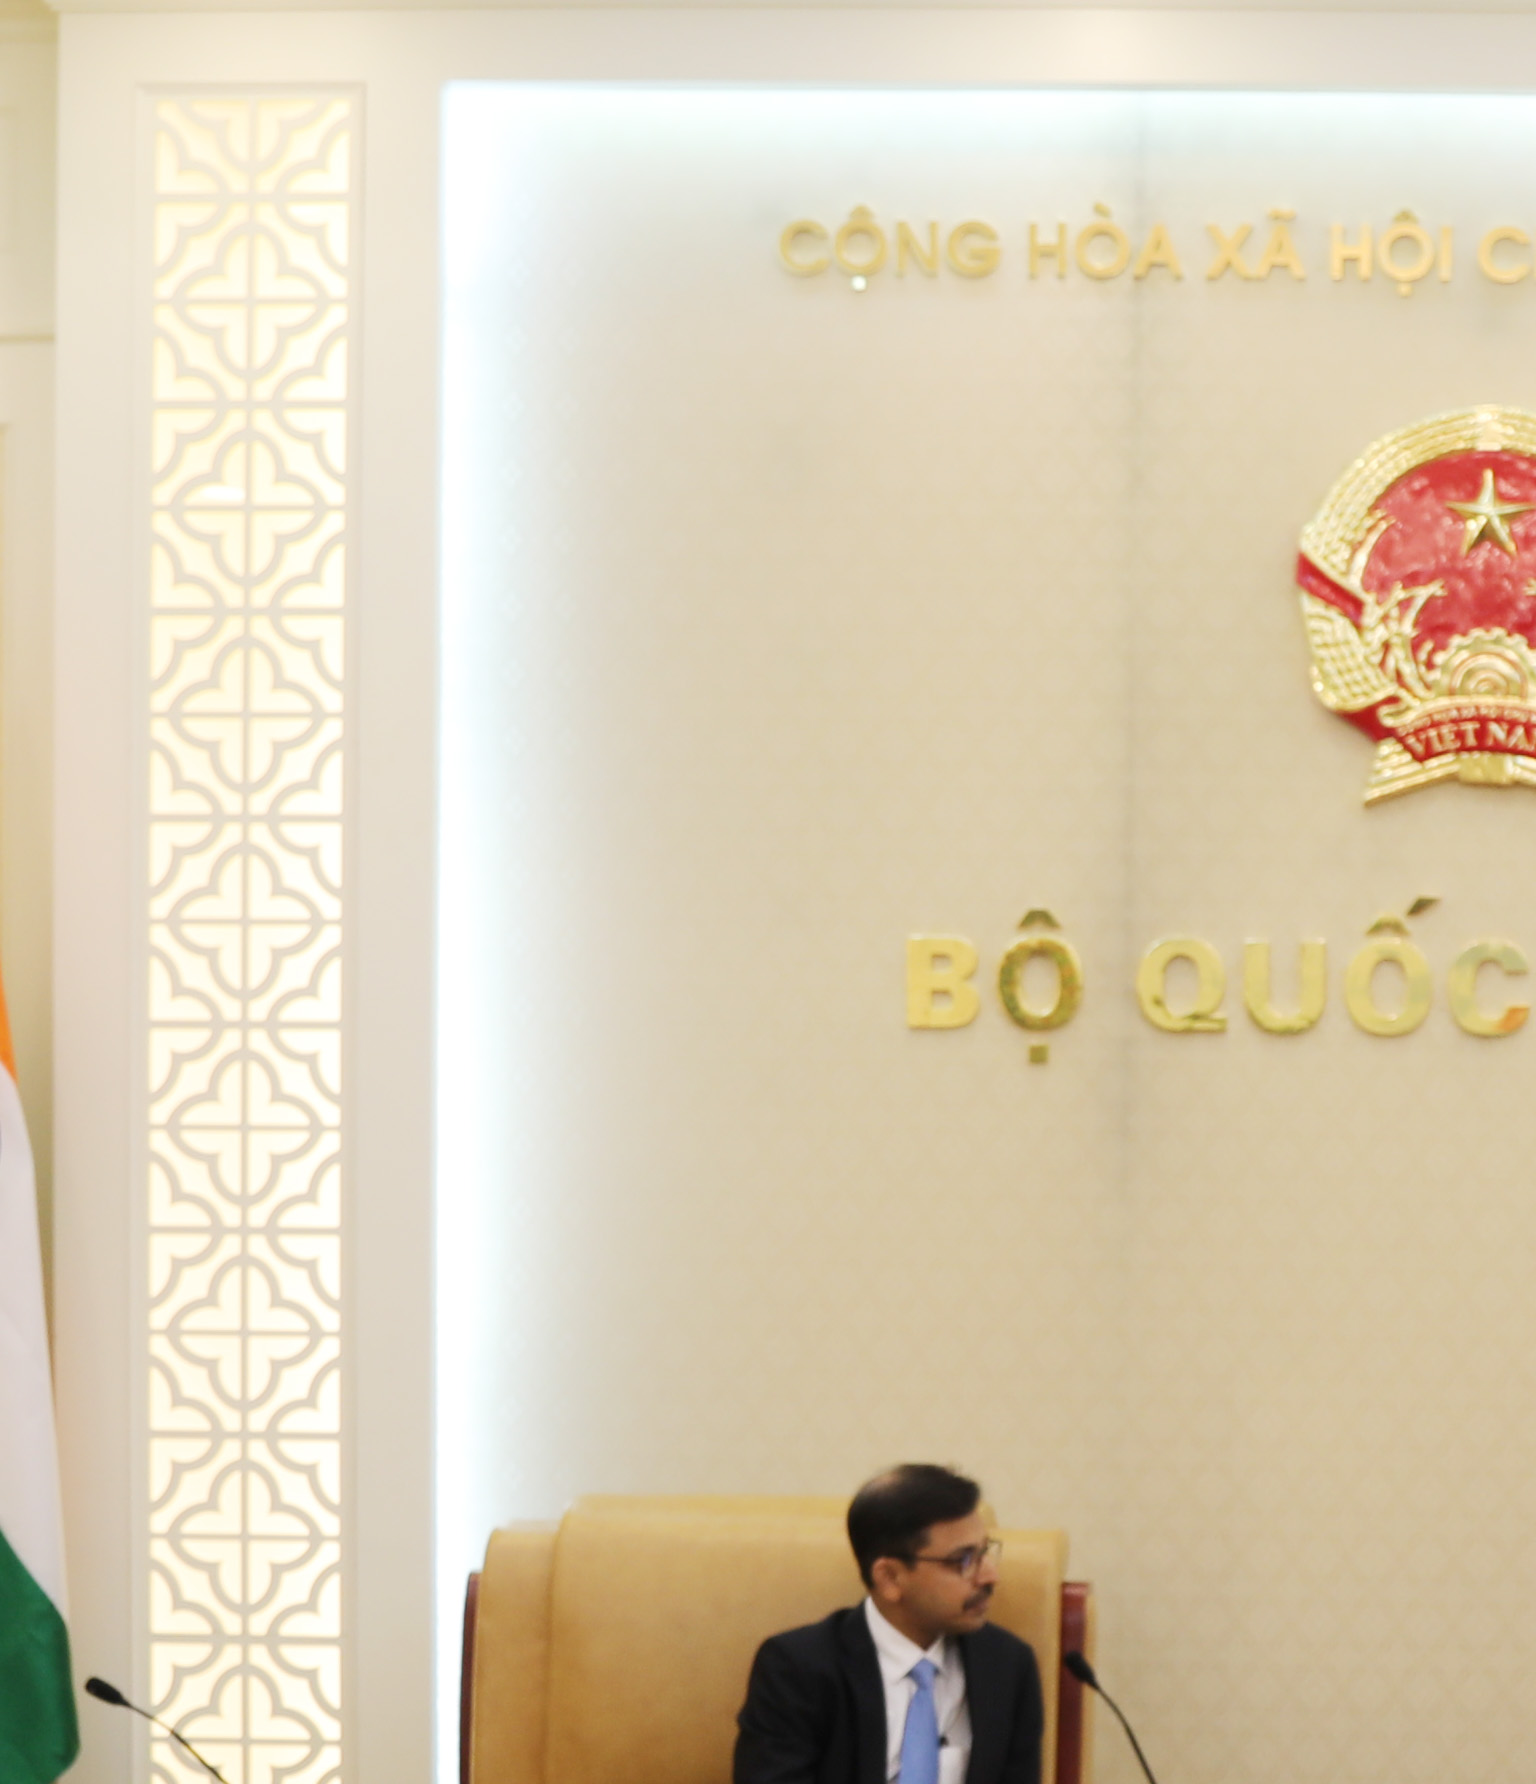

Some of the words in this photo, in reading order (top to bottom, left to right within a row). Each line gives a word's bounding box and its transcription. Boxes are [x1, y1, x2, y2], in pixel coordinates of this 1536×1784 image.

[779, 204, 1002, 292] CỘNG
[1028, 202, 1184, 281] HÒA
[1206, 208, 1307, 281] XÃ
[1330, 209, 1454, 298] HỘI
[906, 908, 1084, 1065] BỘ
[1136, 896, 1531, 1037] QUỐC
